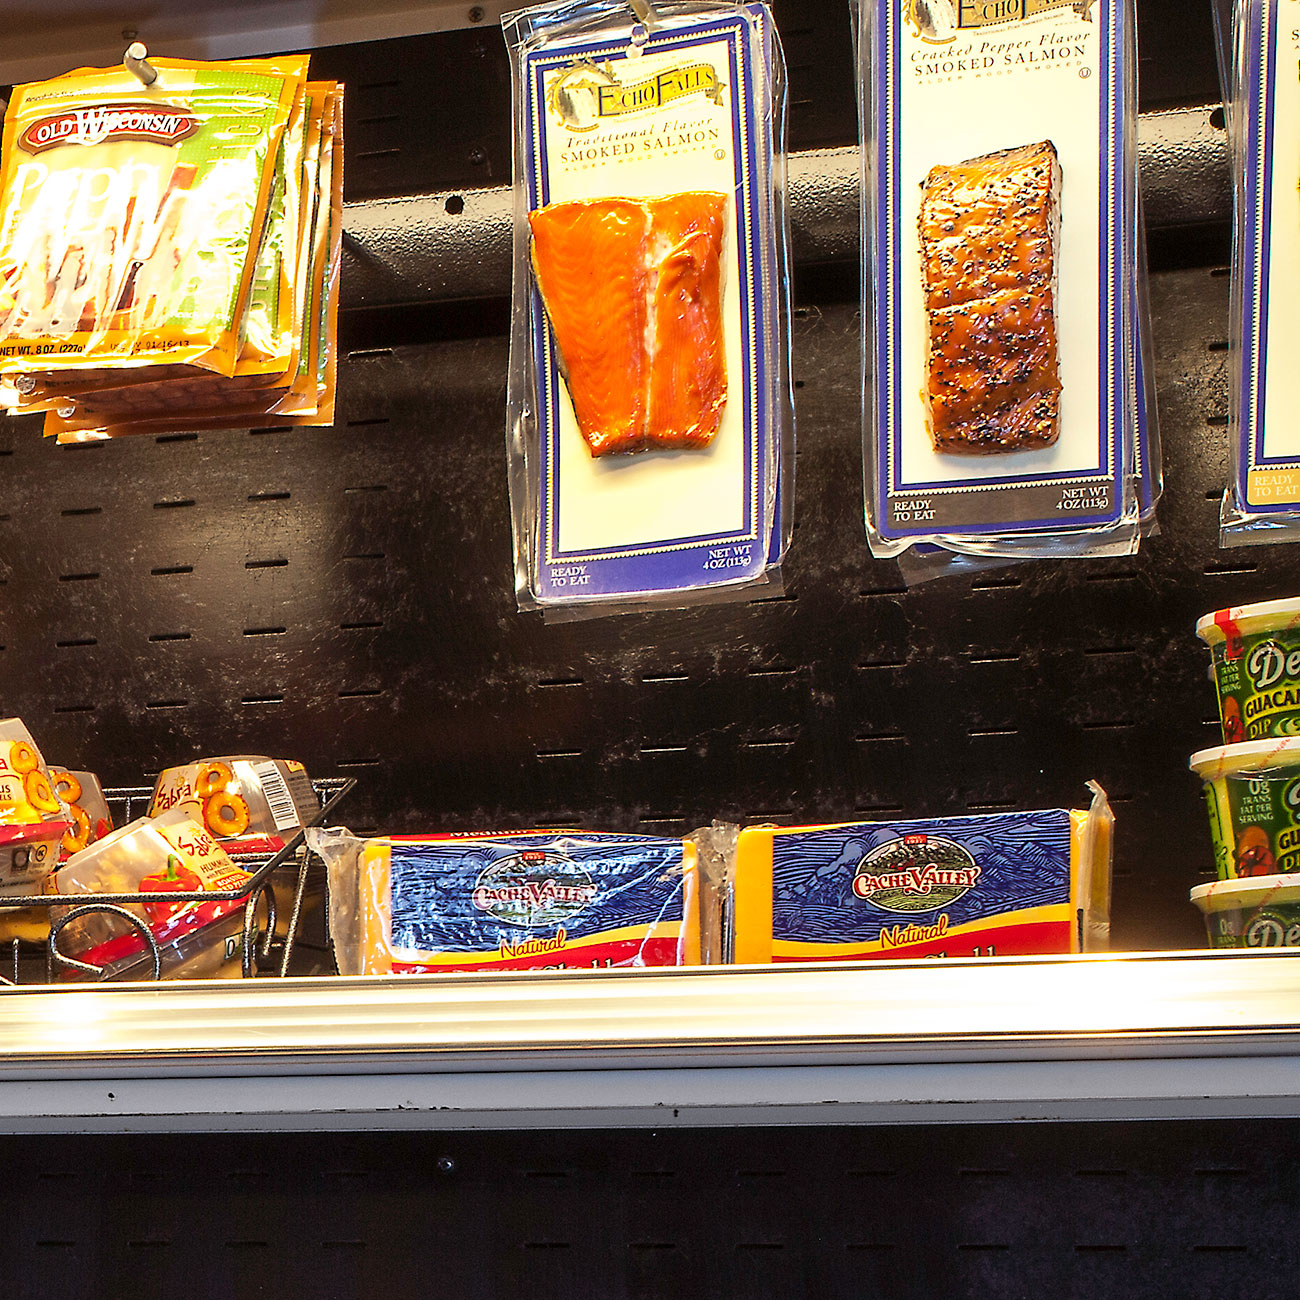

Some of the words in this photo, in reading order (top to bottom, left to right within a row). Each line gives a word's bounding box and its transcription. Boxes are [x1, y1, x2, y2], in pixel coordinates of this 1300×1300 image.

[910, 43, 972, 62] Cracked
[980, 38, 1031, 53] Pepper
[1038, 32, 1091, 46] Flavor
[915, 56, 994, 76] SMOKED
[1004, 45, 1086, 66] SALMON
[36, 121, 72, 142] OLD
[567, 123, 655, 148] Traditional
[663, 117, 713, 133] Flavor
[561, 142, 634, 164] SMOKED
[643, 128, 720, 151] SALMON
[0, 346, 17, 356] NET
[18, 345, 34, 356] WT.
[36, 345, 42, 354] 8
[43, 345, 57, 354] OZ.
[1255, 474, 1293, 486] READY
[1062, 488, 1086, 499] NET
[1089, 486, 1109, 497] WT
[1254, 485, 1273, 497] TO
[1276, 483, 1299, 496] EAT
[894, 500, 932, 512] READY
[1080, 496, 1109, 509] (113g)
[894, 511, 911, 521] TO
[913, 509, 936, 520] EAT
[708, 548, 730, 559] NET
[734, 545, 752, 555] WT
[726, 555, 752, 568] (113g)
[551, 566, 587, 577] READY
[551, 577, 566, 587] TO
[570, 575, 590, 586] EAT
[1250, 719, 1271, 738] DIP
[1248, 779, 1271, 796] 0g
[157, 783, 191, 810] Sabra
[1242, 793, 1272, 805] TRANS
[1240, 805, 1256, 815] FAT
[1257, 803, 1273, 812] PER
[1239, 810, 1274, 824] SERVING
[178, 834, 213, 857] Sabra
[853, 873, 911, 898] CACHE
[904, 863, 982, 895] VALLEY
[880, 914, 949, 949] Natural
[500, 929, 566, 958] Natural
